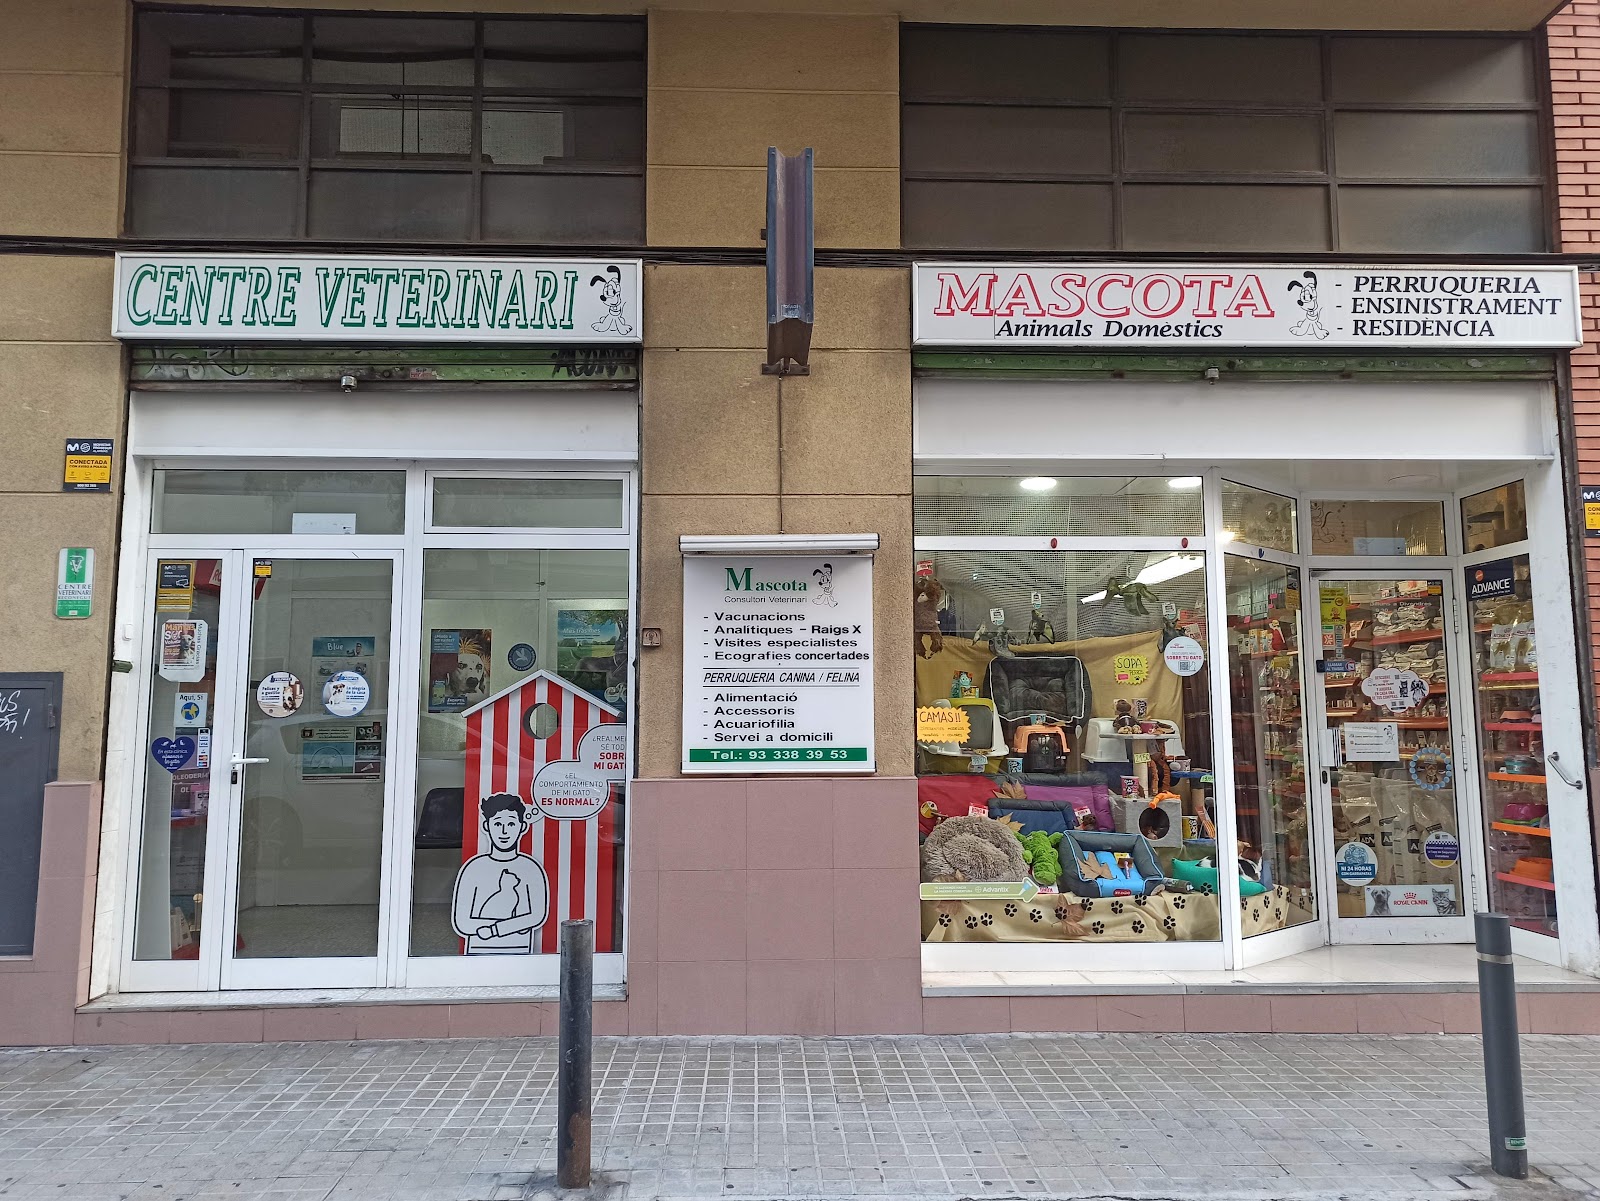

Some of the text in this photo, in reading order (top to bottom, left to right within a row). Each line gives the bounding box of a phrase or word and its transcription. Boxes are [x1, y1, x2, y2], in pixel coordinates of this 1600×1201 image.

[1353, 275, 1541, 297] PERRUQUERIA
[126, 263, 578, 330] CENTRE VETERINARI
[933, 272, 1276, 319] MASCOTA
[1350, 296, 1562, 316] ENSINISTRAMENT
[994, 319, 1223, 339] Animals Domèstics
[1351, 316, 1495, 338] RESIDÈNCIA
[724, 567, 808, 592] Mascota
[1471, 577, 1512, 595] ADVANCE
[724, 595, 808, 603] Consultori Veterinari
[714, 612, 806, 621] Vacunacions
[714, 624, 794, 635] Analítiques
[811, 624, 850, 635] Raigs
[852, 624, 862, 634] X
[327, 642, 344, 651] Blue
[714, 638, 858, 649] Visites especialistes
[714, 651, 870, 662] Ecografies concertades
[1116, 657, 1144, 669] SOPA
[703, 672, 776, 683] PERRUQUERIA
[779, 672, 816, 683] CANINA
[825, 672, 860, 683] FELINA
[714, 692, 798, 702] Alimentació
[714, 706, 795, 716] Accessoris
[919, 711, 961, 723] CAMAS!!
[714, 719, 795, 729] Acuariofilia
[714, 732, 833, 742] Servei a domicili
[710, 749, 848, 760] Tel.: 93 338 39 53
[538, 780, 604, 788] COMPORTAMIENTO
[541, 797, 600, 806] ES NORMAL?
